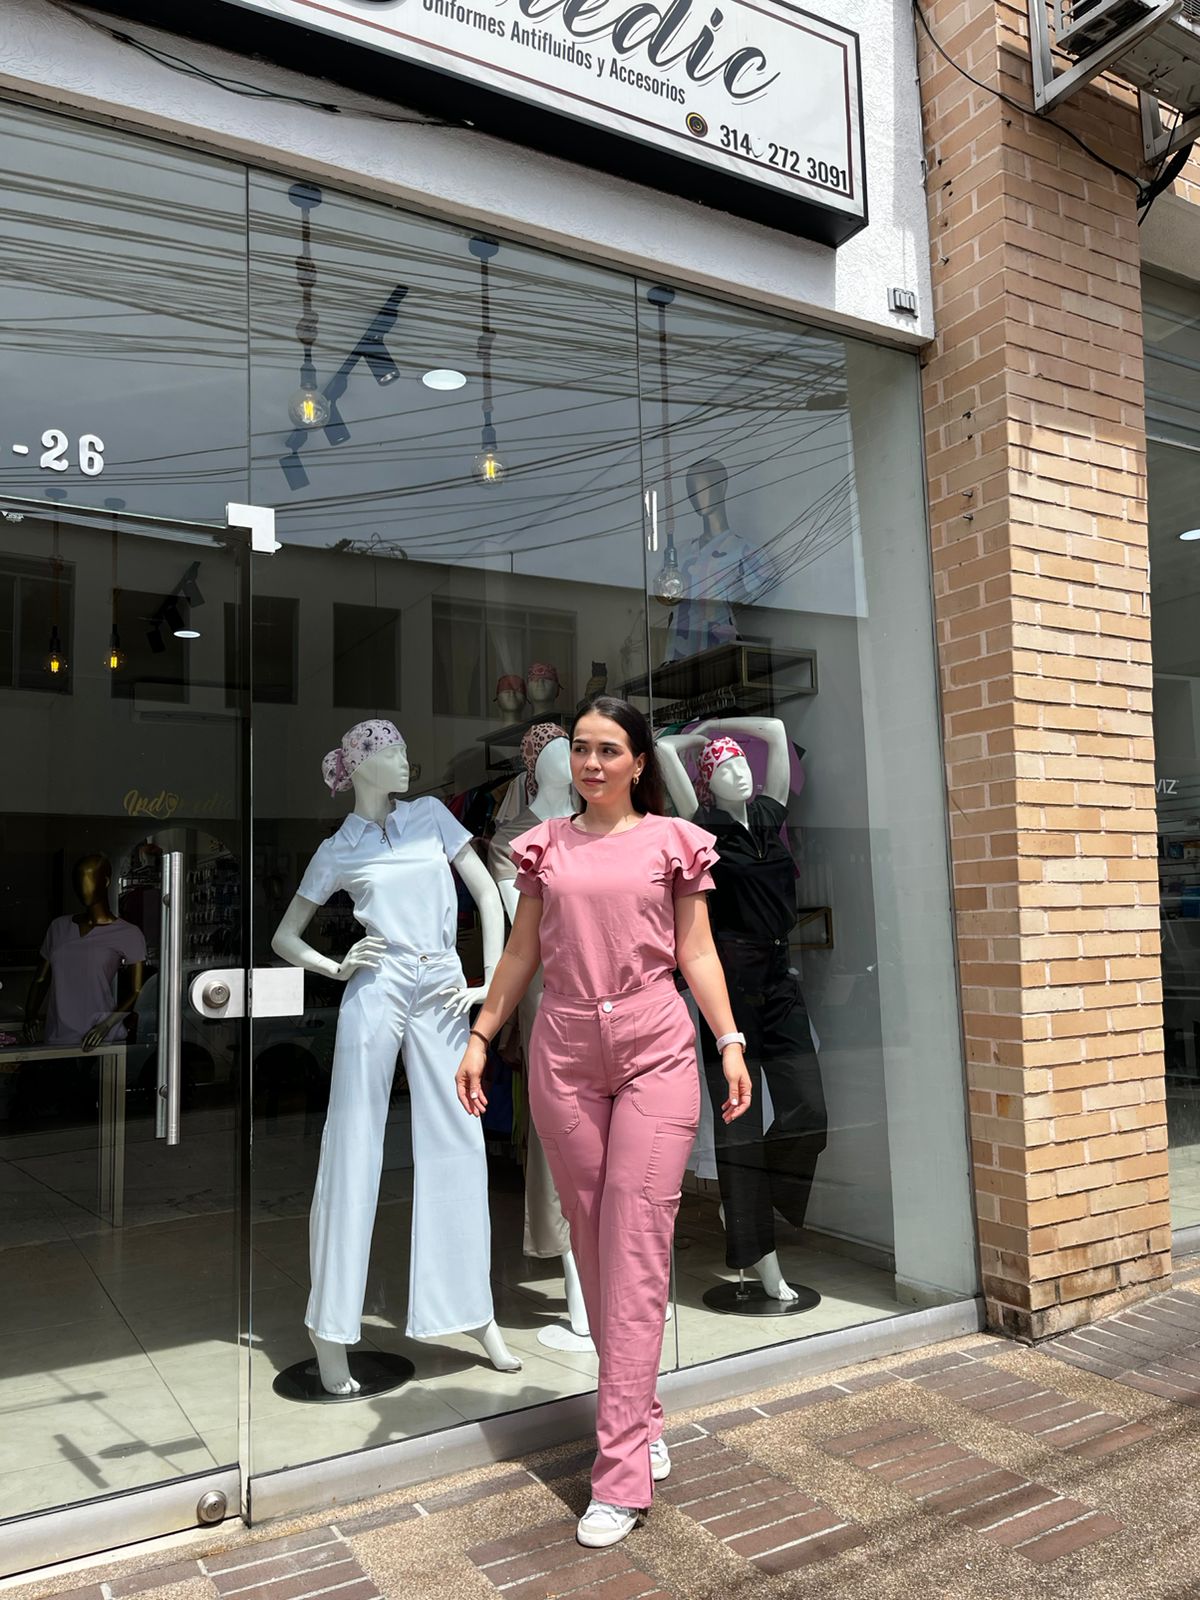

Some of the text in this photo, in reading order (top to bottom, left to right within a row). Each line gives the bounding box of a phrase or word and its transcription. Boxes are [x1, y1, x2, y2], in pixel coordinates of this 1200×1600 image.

[511, 20, 592, 69] Antifluidos
[597, 57, 605, 77] y
[609, 58, 686, 104] Accesorios
[518, 0, 780, 104] edic
[720, 124, 848, 190] 314 272 3091
